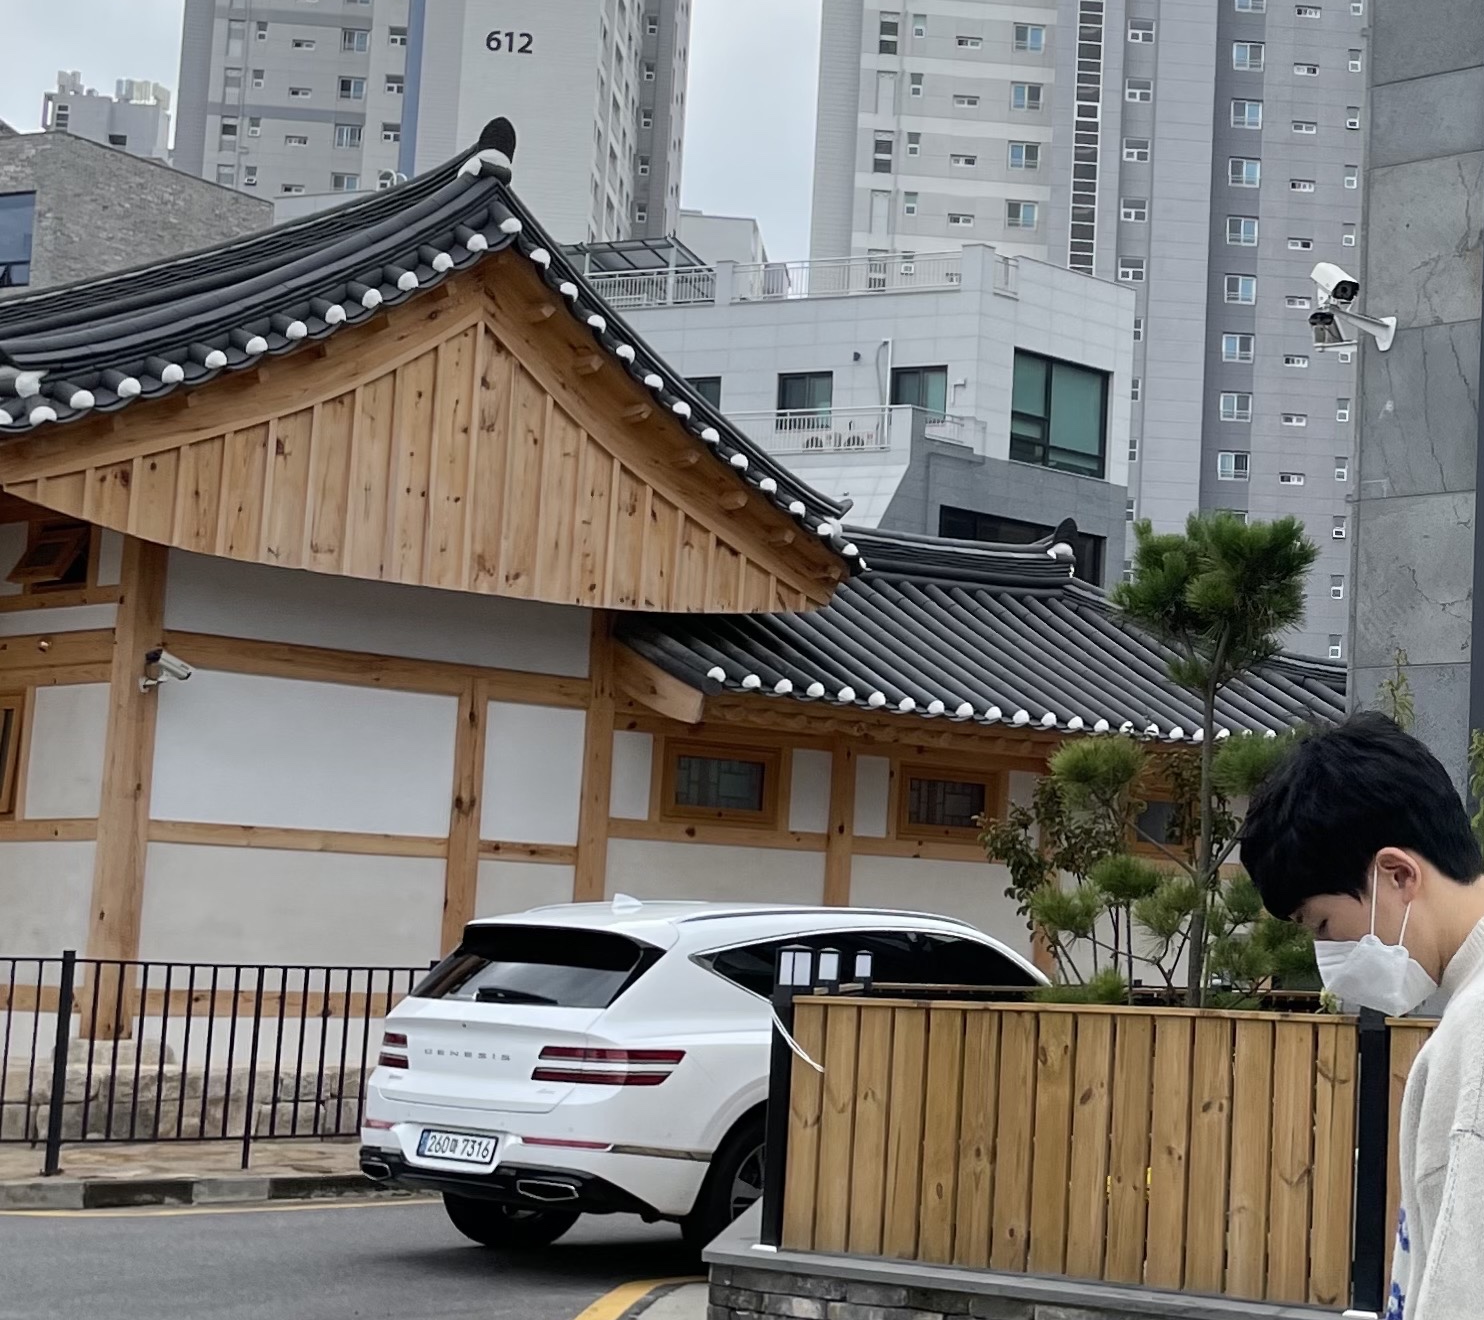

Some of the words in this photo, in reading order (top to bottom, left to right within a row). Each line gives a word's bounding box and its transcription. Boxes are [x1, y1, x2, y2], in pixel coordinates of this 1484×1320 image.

[486, 30, 533, 54] 612
[424, 1048, 511, 1061] GENESIS
[460, 1139, 491, 1159] 7316
